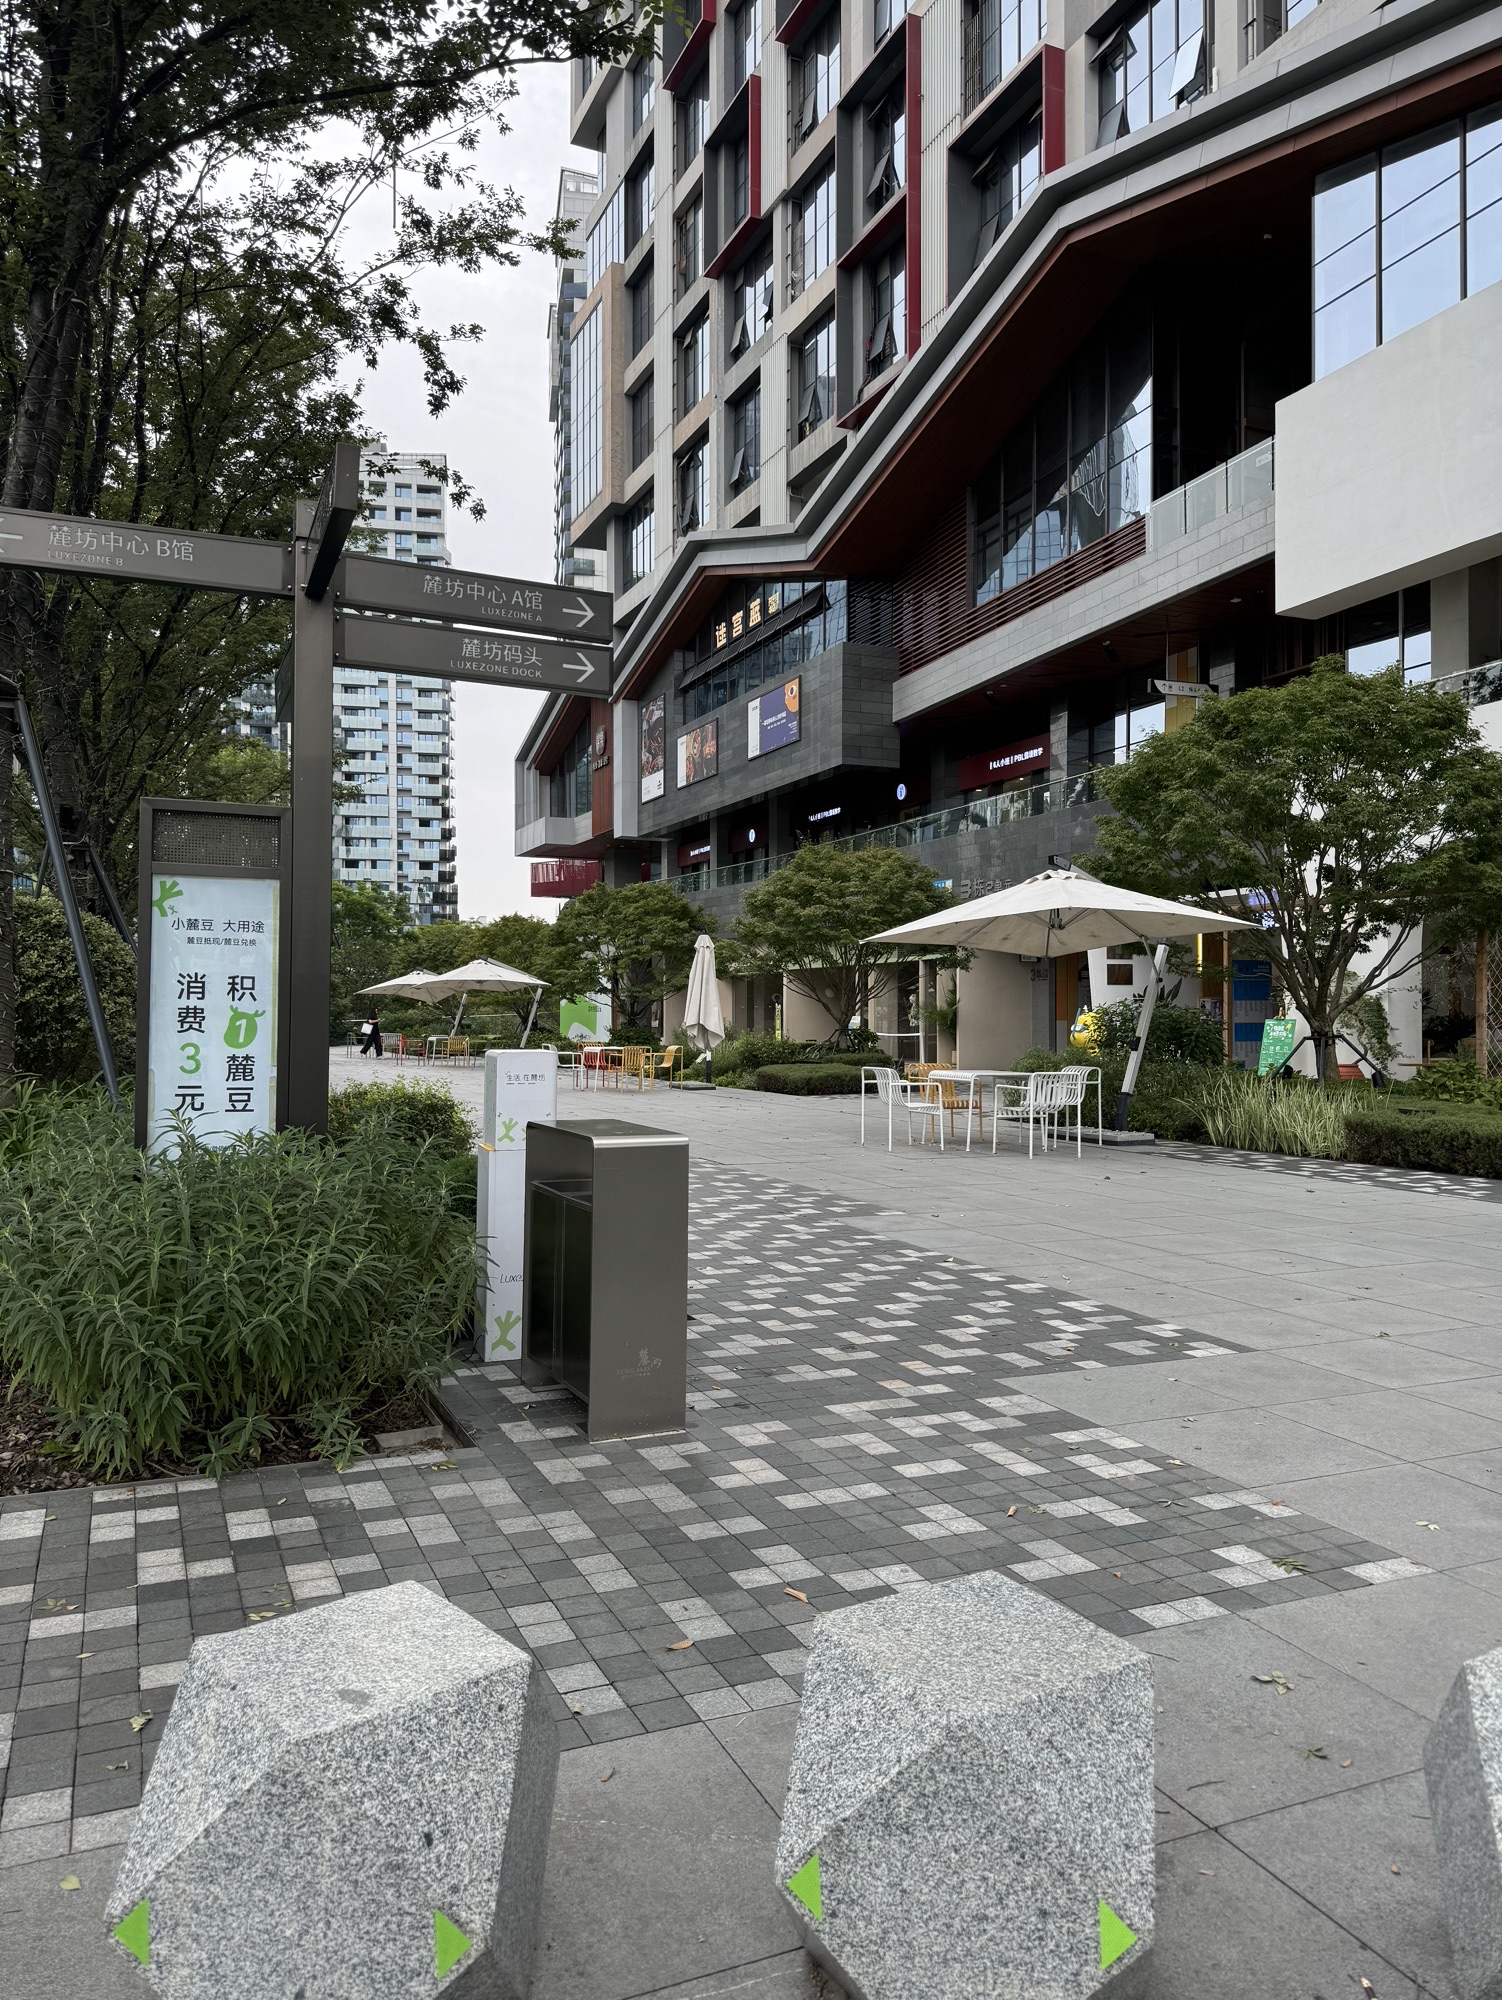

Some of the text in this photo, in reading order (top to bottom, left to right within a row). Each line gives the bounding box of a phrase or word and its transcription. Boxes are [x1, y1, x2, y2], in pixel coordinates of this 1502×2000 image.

[48, 524, 194, 562] 麓坊中心 B馆
[48, 550, 123, 567] LUXEZONE B
[422, 574, 543, 611] 麓坊中心 A馆
[481, 606, 542, 622] LUXEZONE A
[461, 637, 543, 667] 麓坊码头
[450, 659, 543, 679] LUXEZONE DOCK
[171, 917, 265, 933] 小麓豆 大用途
[186, 936, 257, 947] 麓豆抵现/麓豆兑换
[175, 972, 207, 1112] 消费3元
[506, 1073, 521, 1082] 生活
